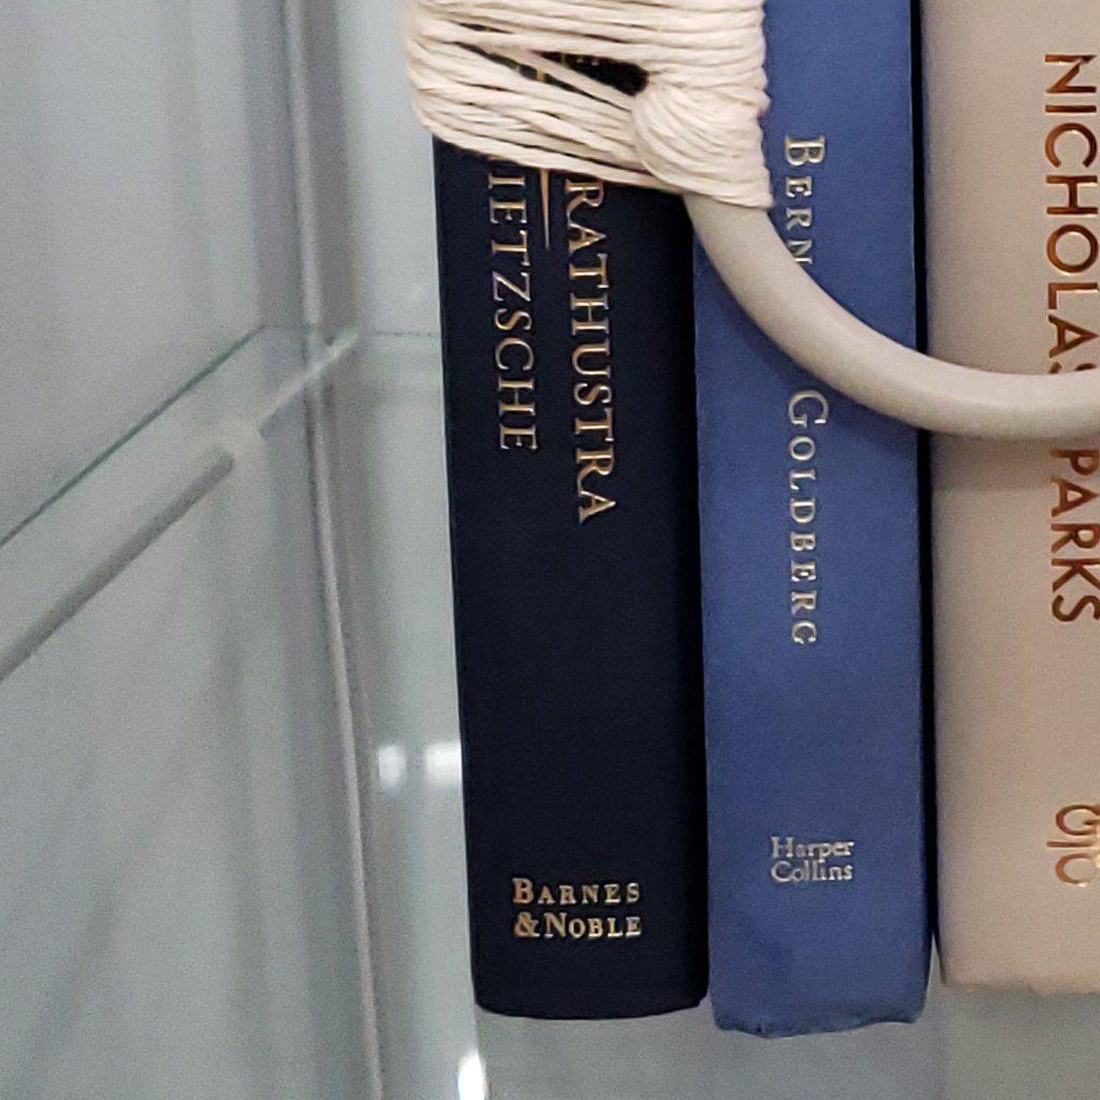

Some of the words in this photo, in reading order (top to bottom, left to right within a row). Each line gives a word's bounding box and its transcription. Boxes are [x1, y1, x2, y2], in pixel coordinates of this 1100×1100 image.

[785, 135, 826, 265] BERN
[488, 172, 539, 450] IETZSCHE
[565, 178, 617, 523] RATHUSTRA
[788, 389, 830, 645] GOLDBERG
[511, 877, 641, 905] BARNES
[771, 836, 855, 863] Harper
[771, 860, 853, 883] Collins
